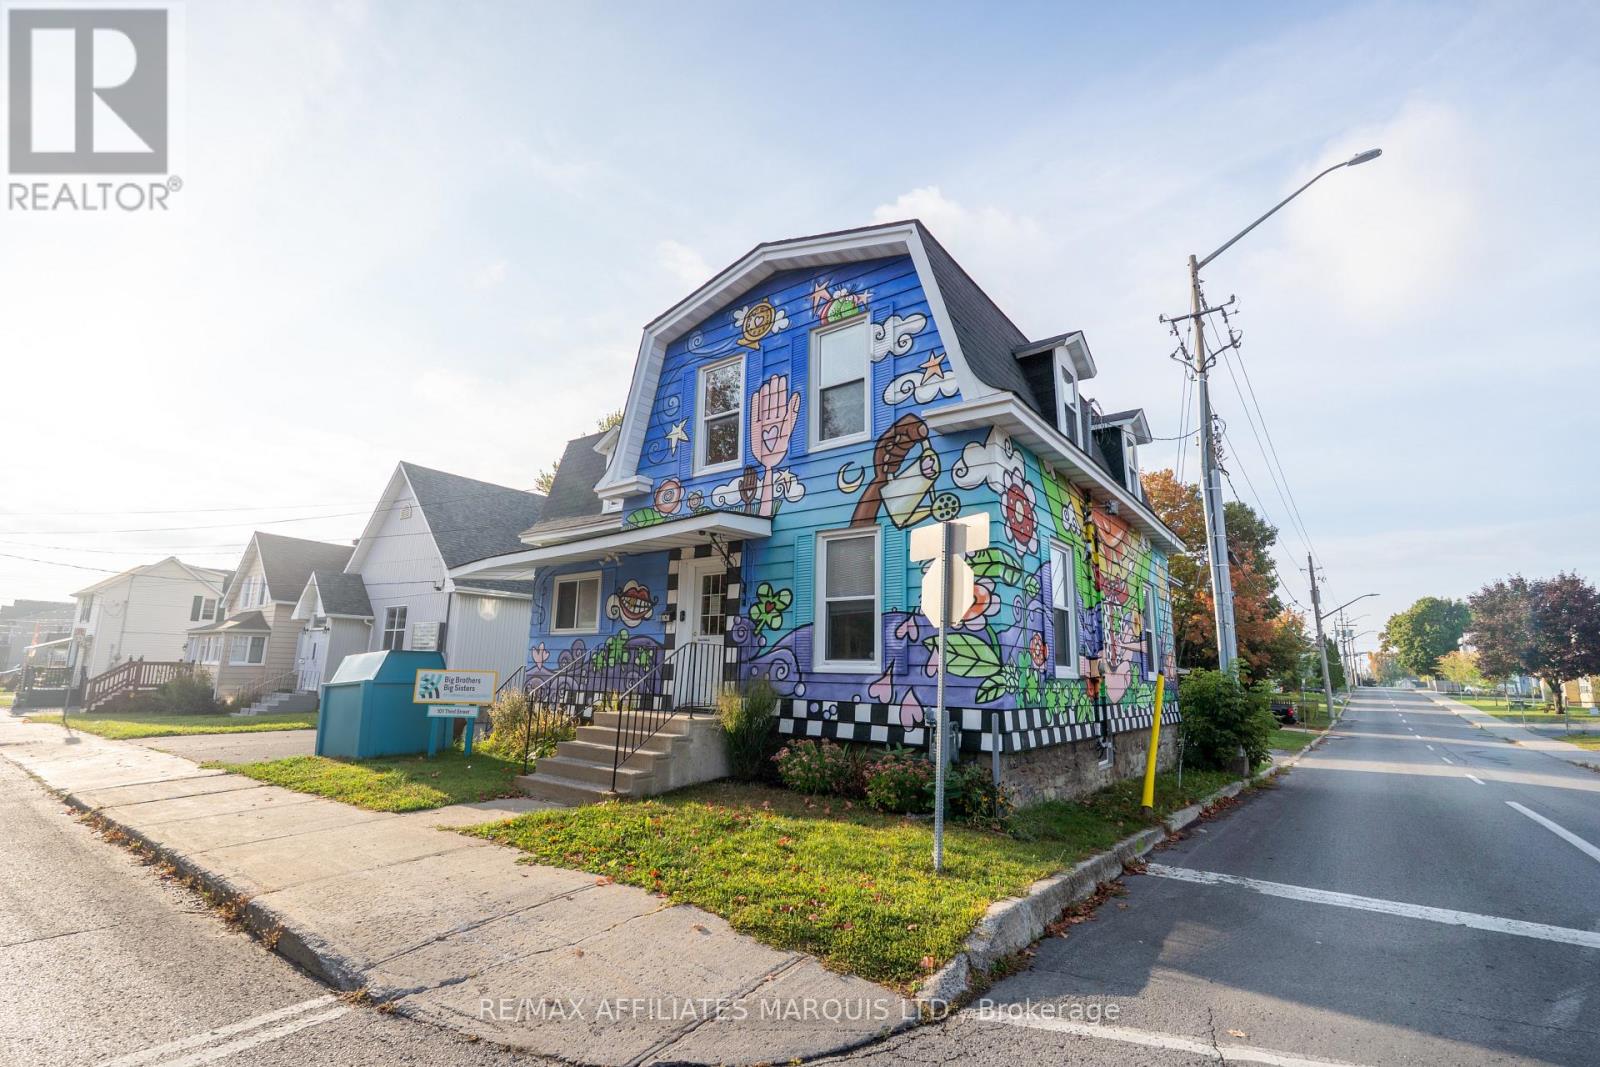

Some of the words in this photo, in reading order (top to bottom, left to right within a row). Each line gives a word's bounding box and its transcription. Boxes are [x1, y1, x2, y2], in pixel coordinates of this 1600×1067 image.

[444, 676, 454, 684] Big
[455, 676, 481, 684] Brothers
[443, 684, 453, 692] Big
[454, 684, 476, 692] Sisters
